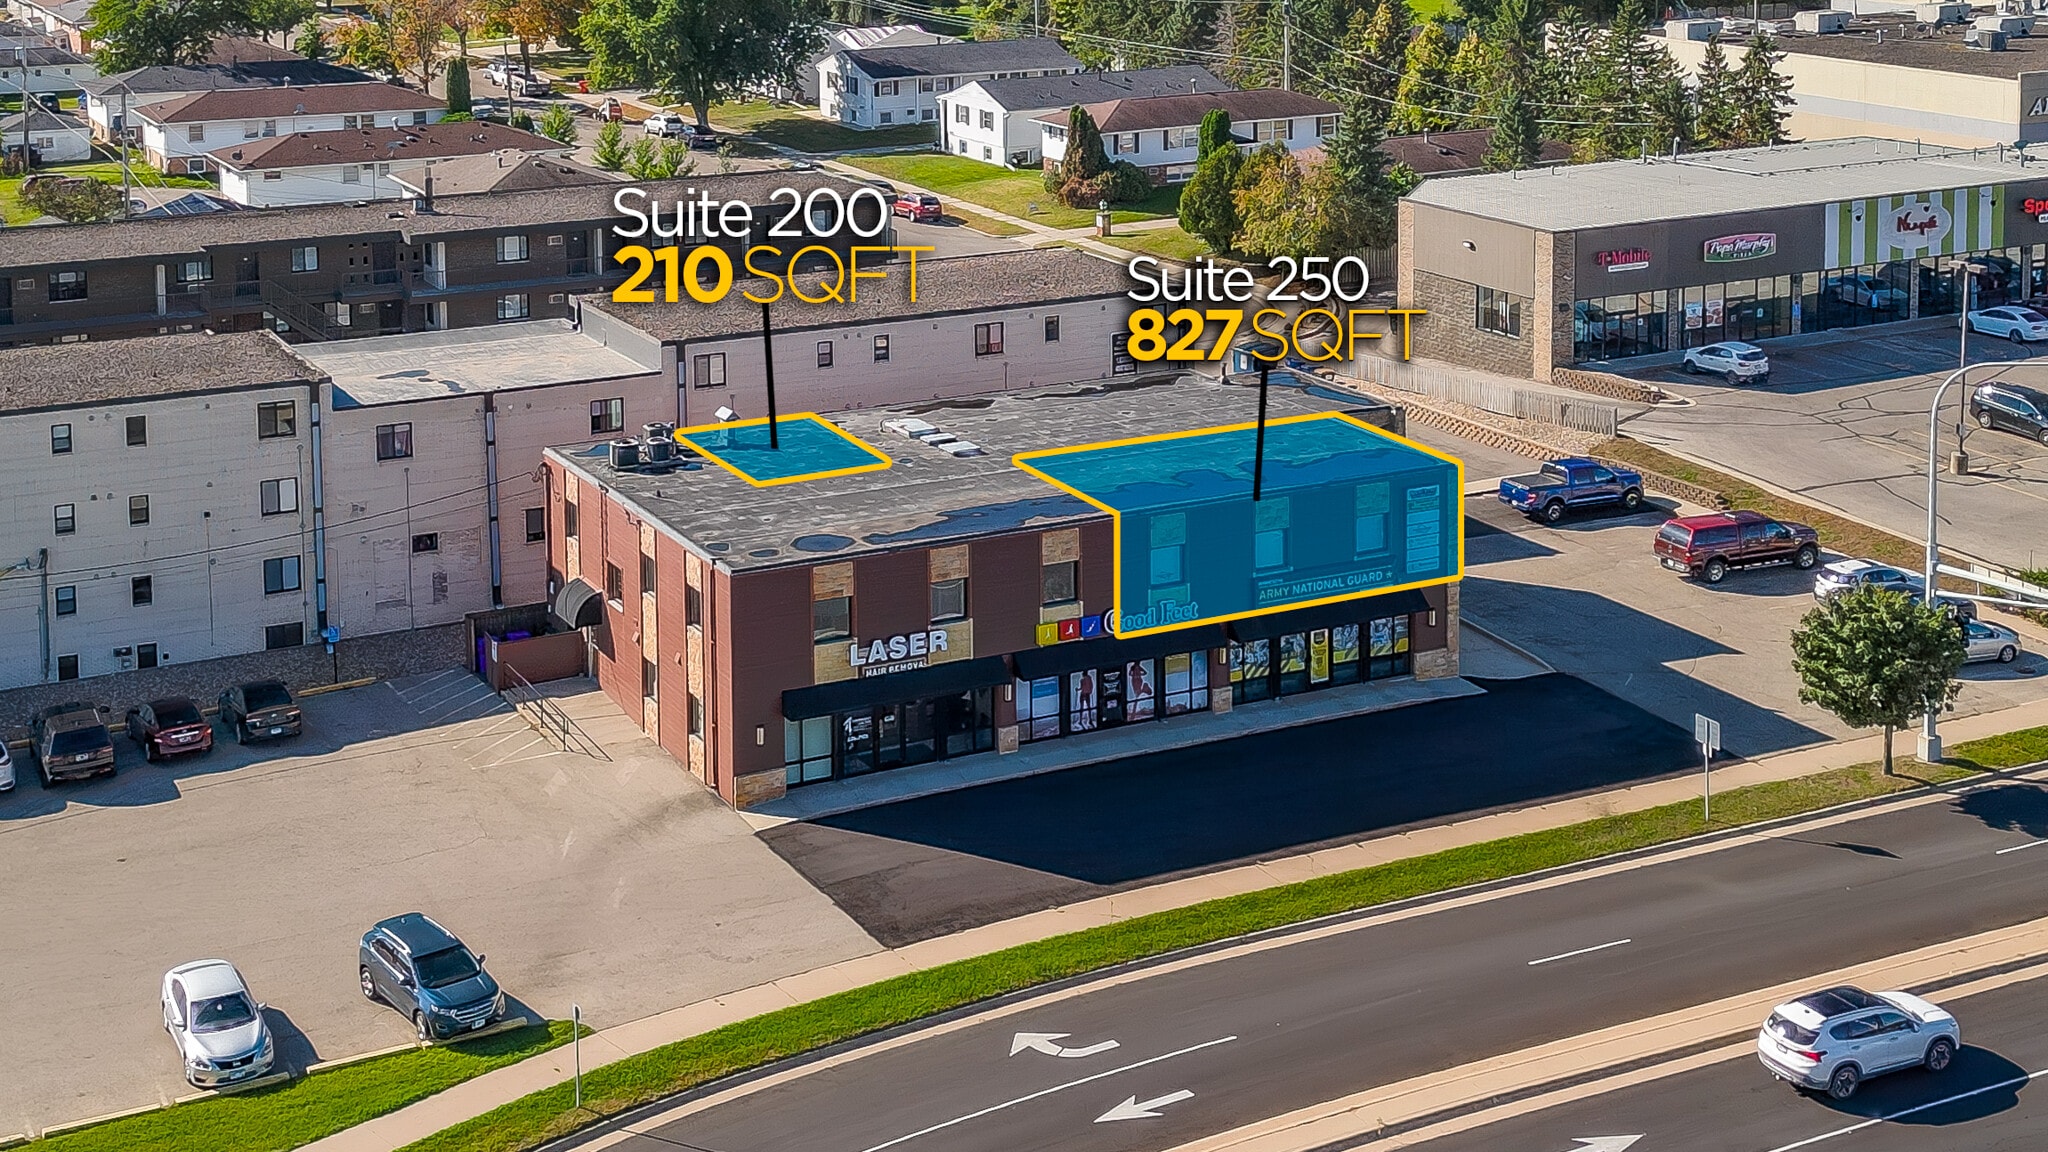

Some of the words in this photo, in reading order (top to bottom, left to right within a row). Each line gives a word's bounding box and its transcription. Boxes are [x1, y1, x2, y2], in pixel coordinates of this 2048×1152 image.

[1598, 248, 1650, 266] T-Mobile
[1259, 586, 1290, 600] ARMY
[1291, 577, 1345, 595] NATIONAL
[1347, 571, 1383, 586] GUARD
[1104, 607, 1156, 634] Good
[1160, 600, 1199, 625] Feet
[850, 630, 948, 667] LASER
[866, 667, 887, 678] HAIR
